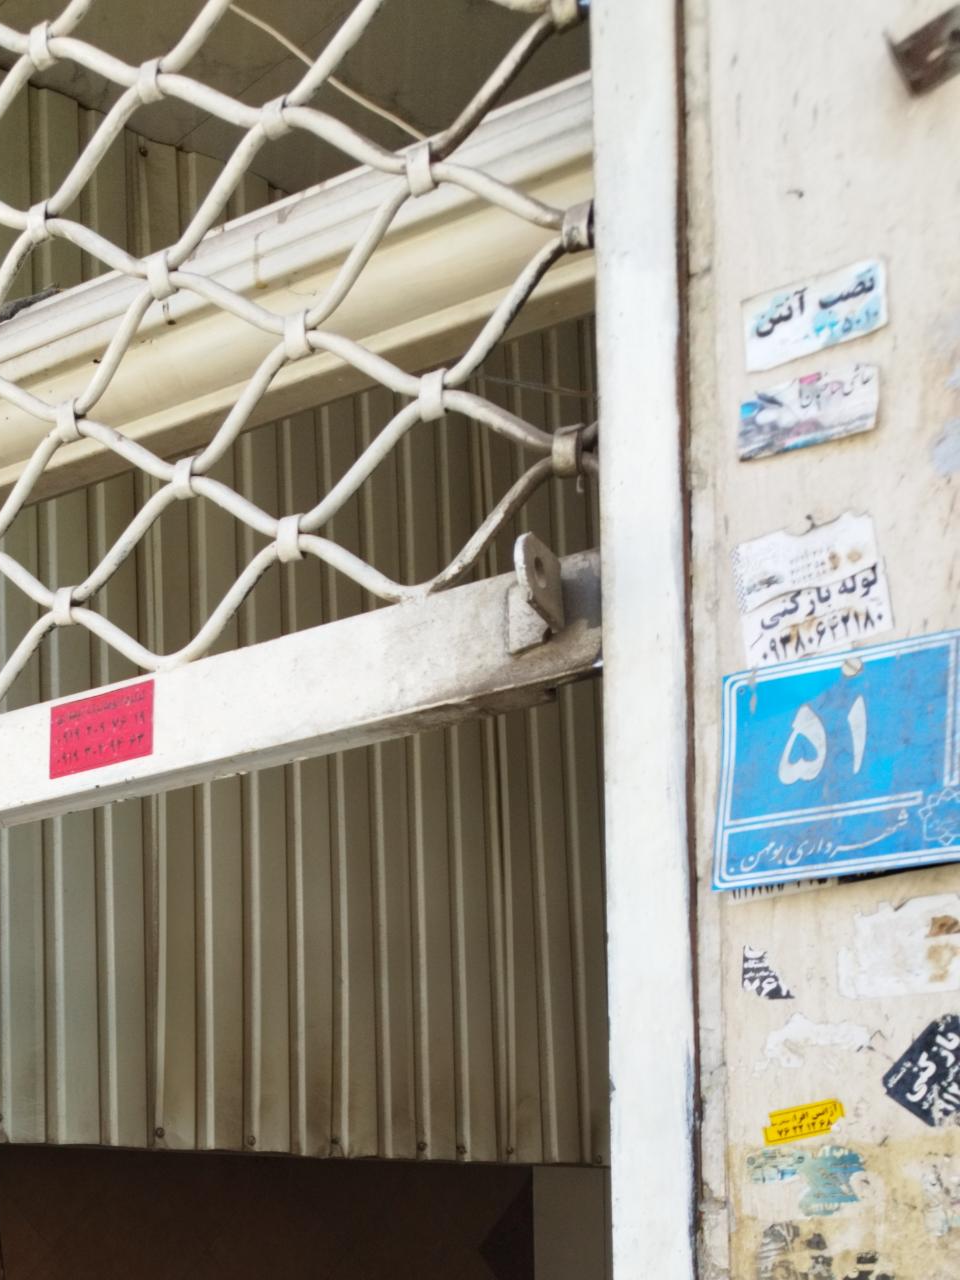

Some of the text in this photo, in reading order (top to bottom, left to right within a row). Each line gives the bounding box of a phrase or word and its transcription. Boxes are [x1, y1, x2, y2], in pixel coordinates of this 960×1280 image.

[754, 268, 877, 338] نصب آنتن
[760, 585, 831, 631] بازکنی
[838, 562, 879, 598] لوله
[778, 695, 868, 785] ۵۱
[740, 809, 909, 872] شهرداری بومهن
